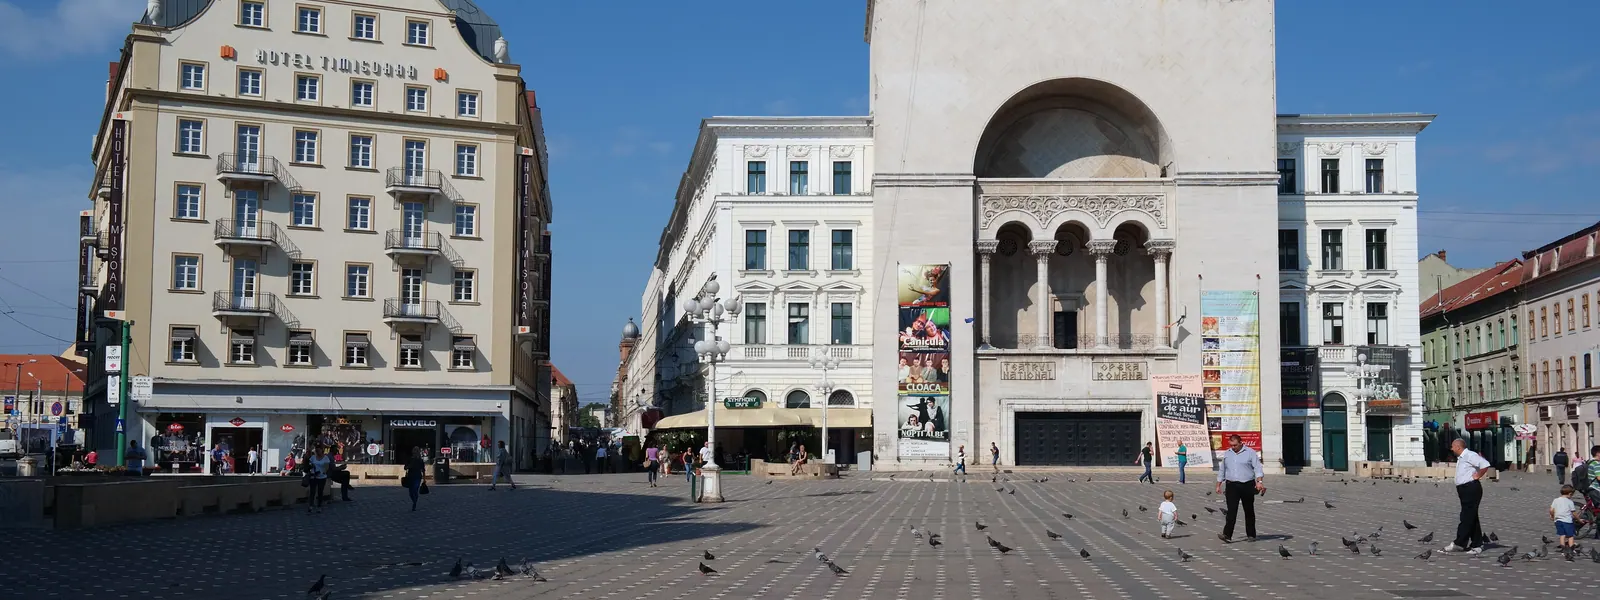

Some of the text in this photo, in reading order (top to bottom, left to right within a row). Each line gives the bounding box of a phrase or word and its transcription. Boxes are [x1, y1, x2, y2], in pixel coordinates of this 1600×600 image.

[256, 48, 314, 69] HOTEL
[113, 127, 122, 190] HOTEL
[904, 337, 944, 346] Canicula
[1101, 363, 1139, 371] OPERA
[1004, 371, 1053, 380] NATIONAL
[906, 383, 941, 391] CLOACA
[1164, 404, 1201, 414] de aur
